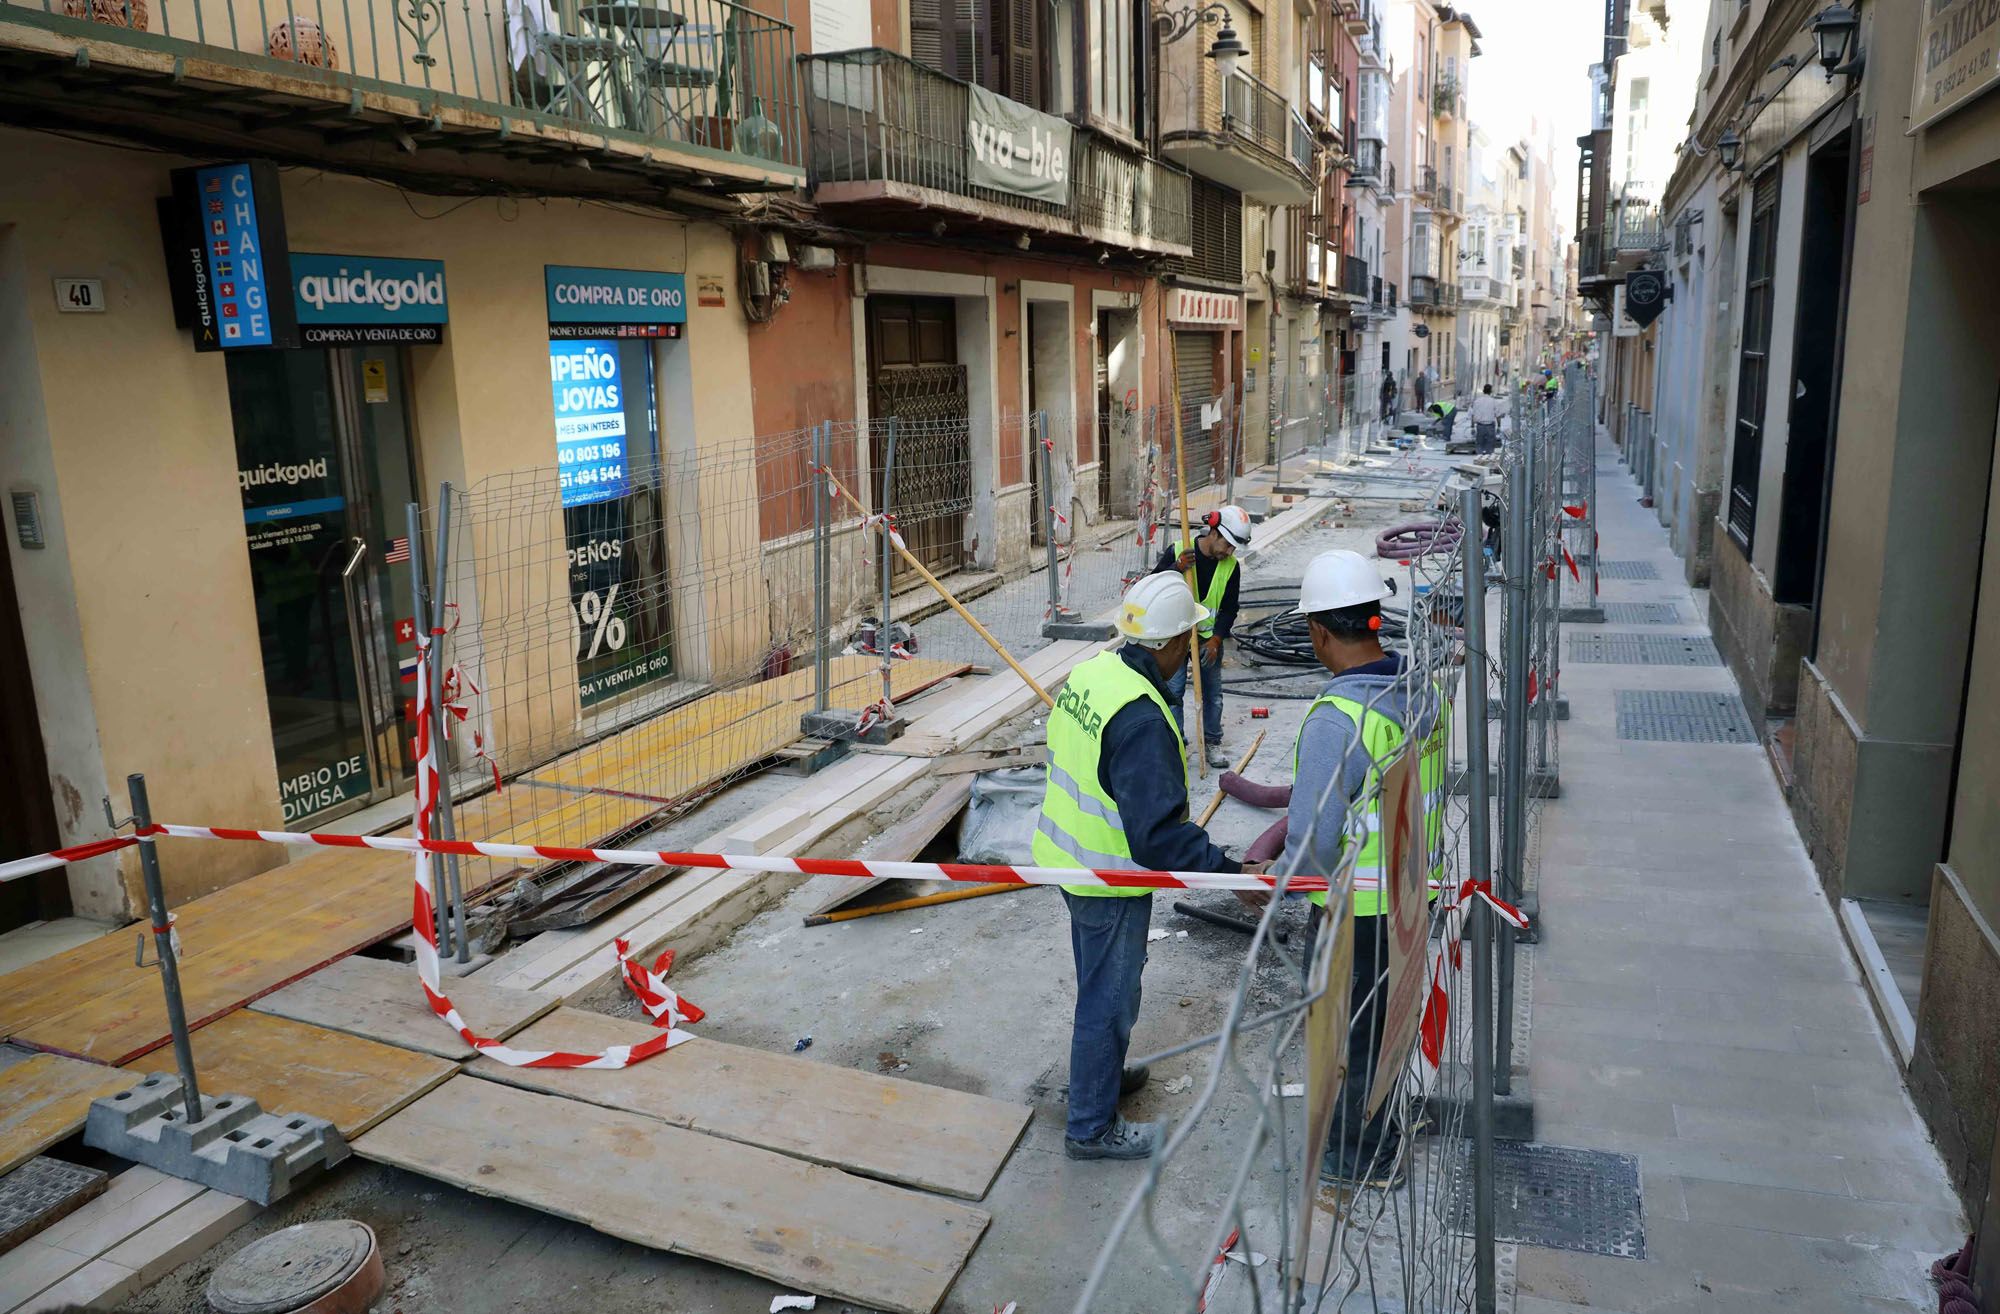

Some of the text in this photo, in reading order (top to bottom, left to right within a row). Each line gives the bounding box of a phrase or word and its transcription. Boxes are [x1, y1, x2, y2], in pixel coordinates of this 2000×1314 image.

[1926, 0, 2000, 74] RAMIRE
[231, 174, 265, 337] CHANGE
[69, 284, 91, 306] 40
[190, 248, 212, 326] quickgold
[300, 268, 443, 311] quickgold
[555, 284, 681, 307] COMPRA DE ORO
[306, 329, 436, 342] COMPRA Y VENTA DE ORO
[549, 326, 617, 336] MONEY EXCHANGE
[559, 385, 619, 412] JOYAS
[576, 445, 599, 462] 803
[600, 443, 621, 459] 196
[238, 457, 328, 490] quickgold
[560, 464, 622, 487] 51 494 544
[566, 538, 621, 569] PEÑOS
[580, 655, 668, 697] RA Y VENTA DE ORO
[336, 756, 361, 779] DE
[282, 784, 346, 821] DIVISA
